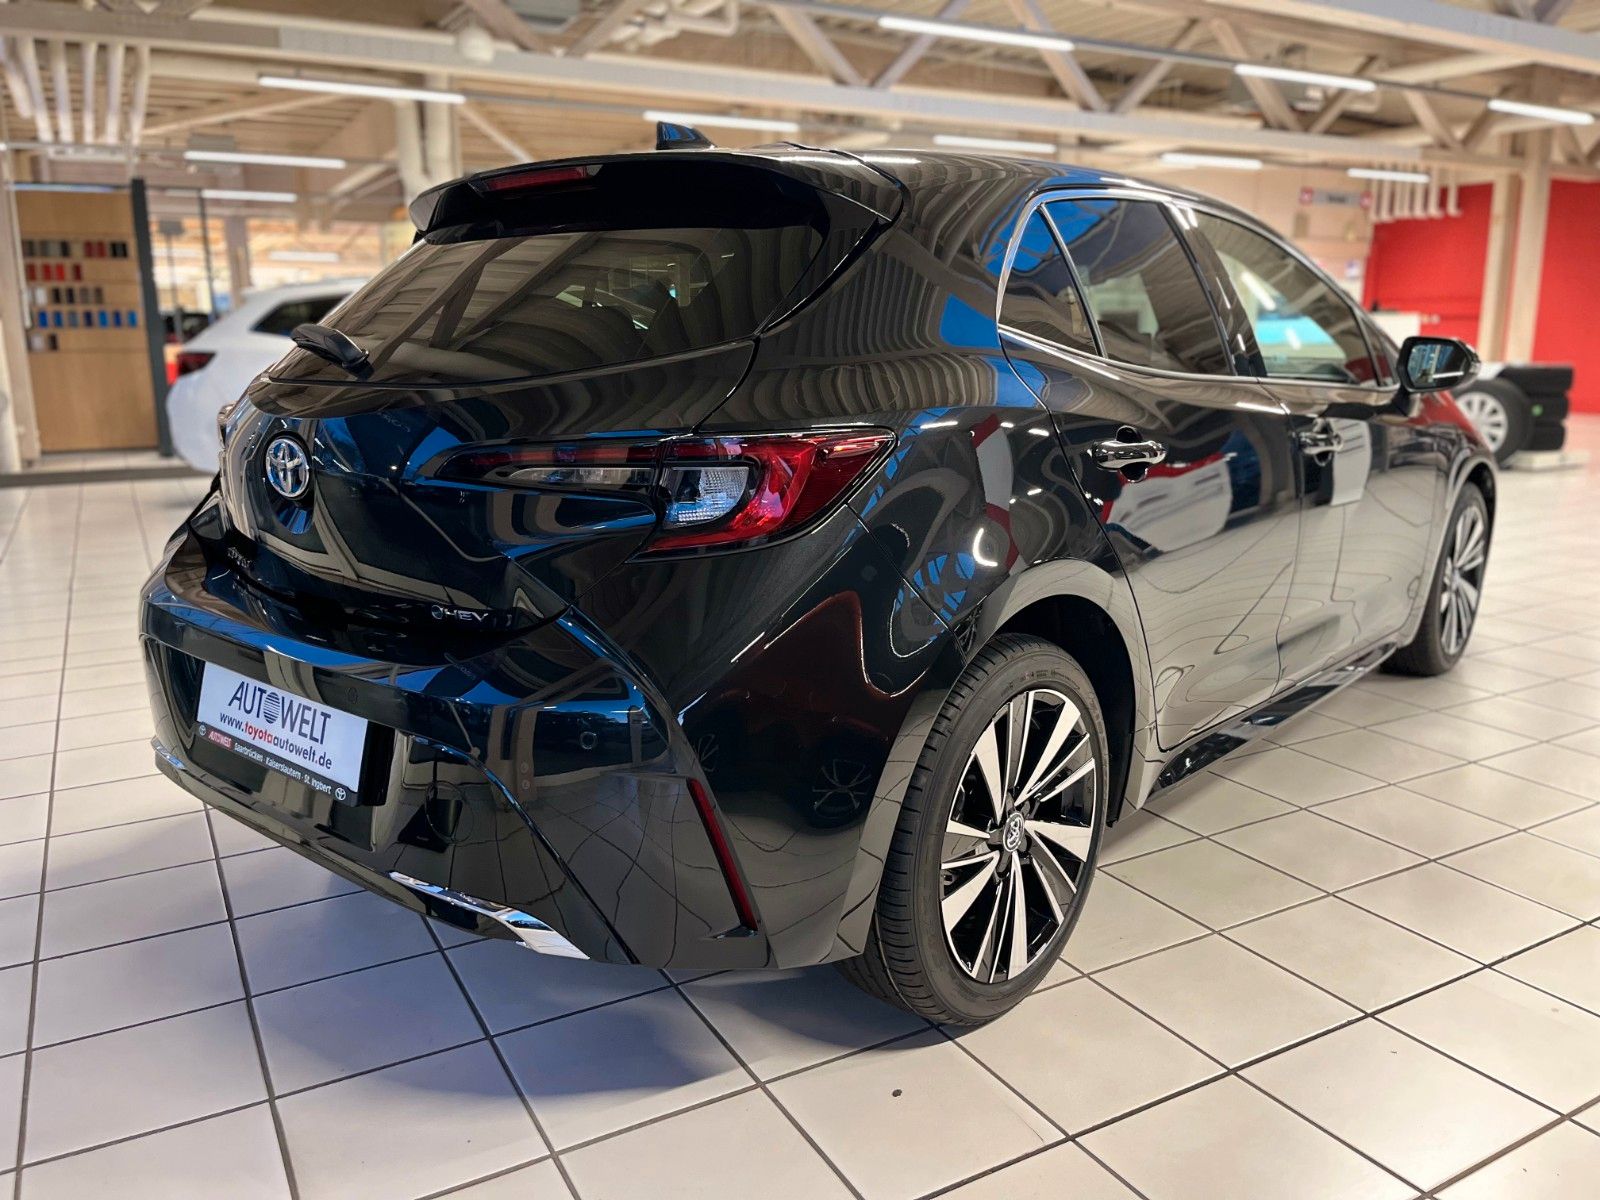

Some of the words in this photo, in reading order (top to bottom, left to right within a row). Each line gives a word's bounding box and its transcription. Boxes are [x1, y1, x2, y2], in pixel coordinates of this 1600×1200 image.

[443, 608, 489, 622] HEV
[228, 681, 332, 745] AUTOWELT
[219, 712, 333, 770] www.toyotaautowelt.de
[234, 742, 264, 763] Saarbrücken
[265, 757, 302, 780] Kaiserslautern
[311, 776, 332, 795] Ingbert
